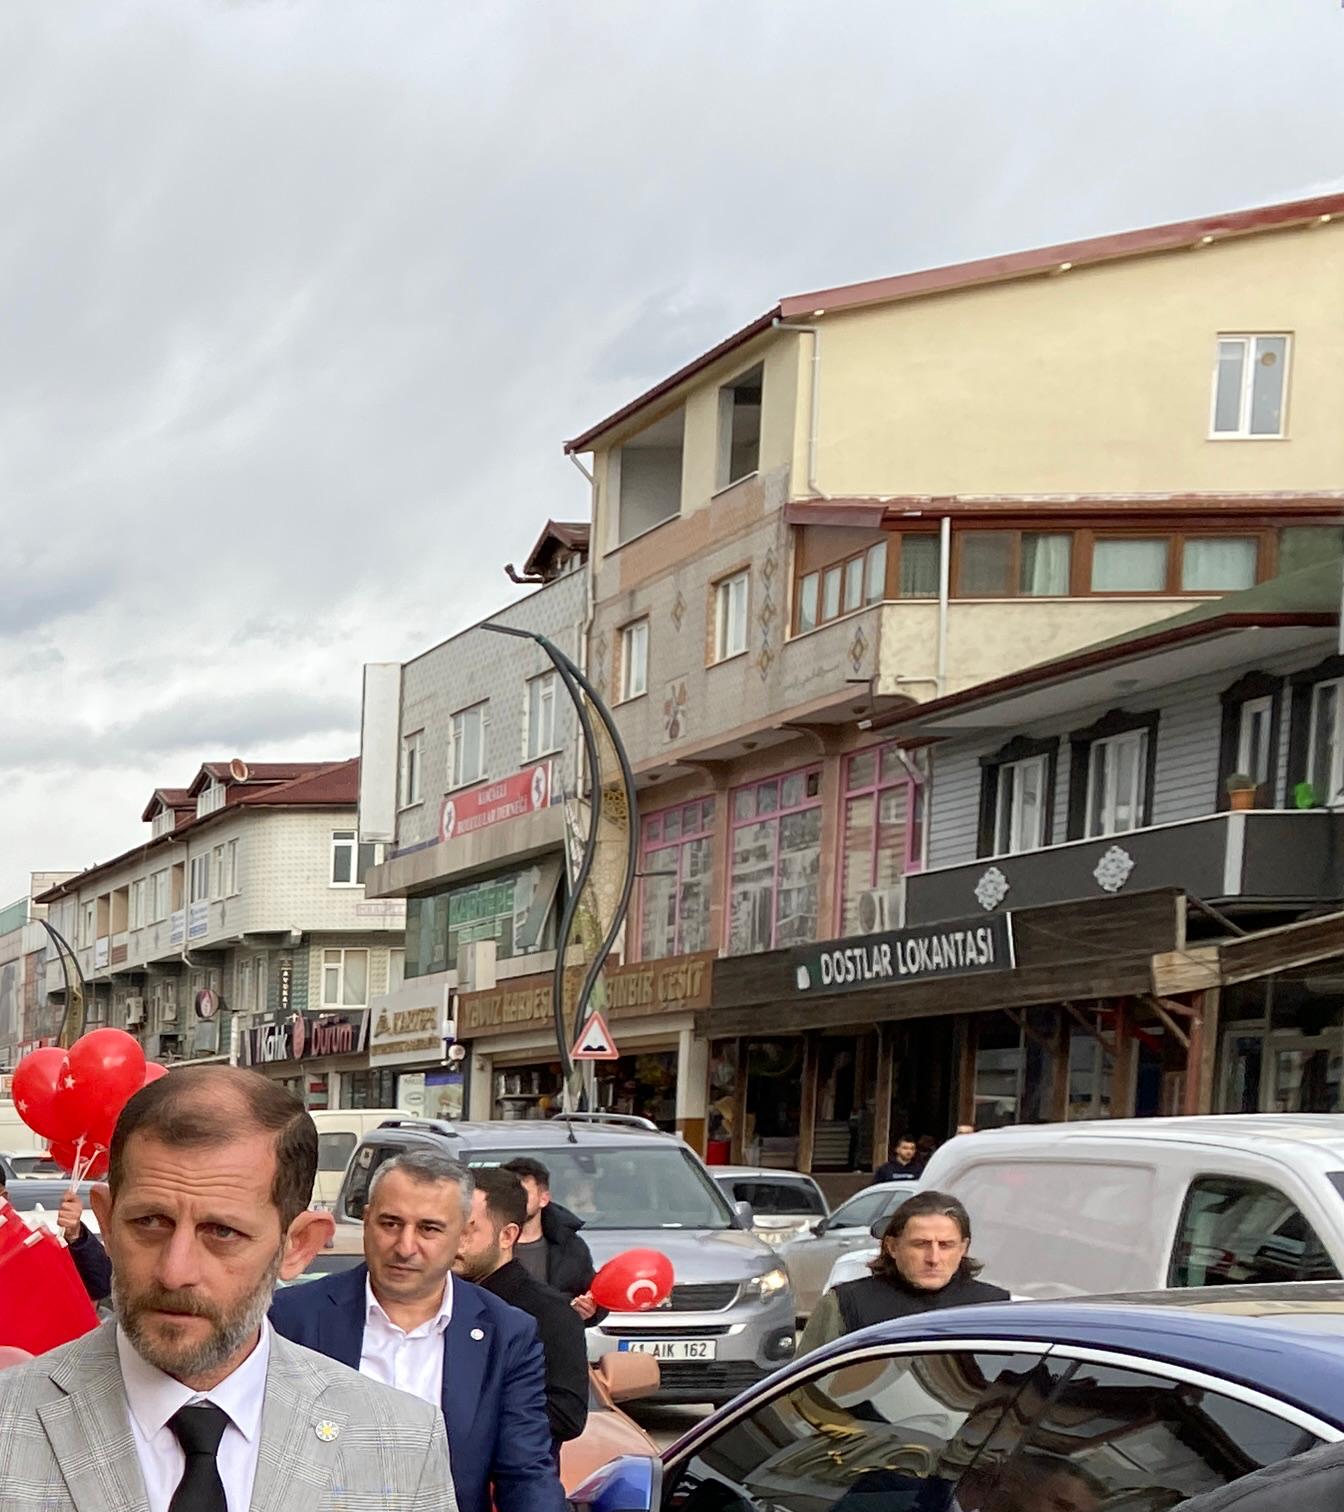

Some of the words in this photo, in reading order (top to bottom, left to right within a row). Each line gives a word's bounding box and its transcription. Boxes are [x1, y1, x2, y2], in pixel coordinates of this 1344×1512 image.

[820, 943, 894, 985] DOSTLAR
[896, 928, 995, 975] LOKANTASI
[653, 1343, 675, 1358] AIK
[683, 1342, 707, 1358] 162
